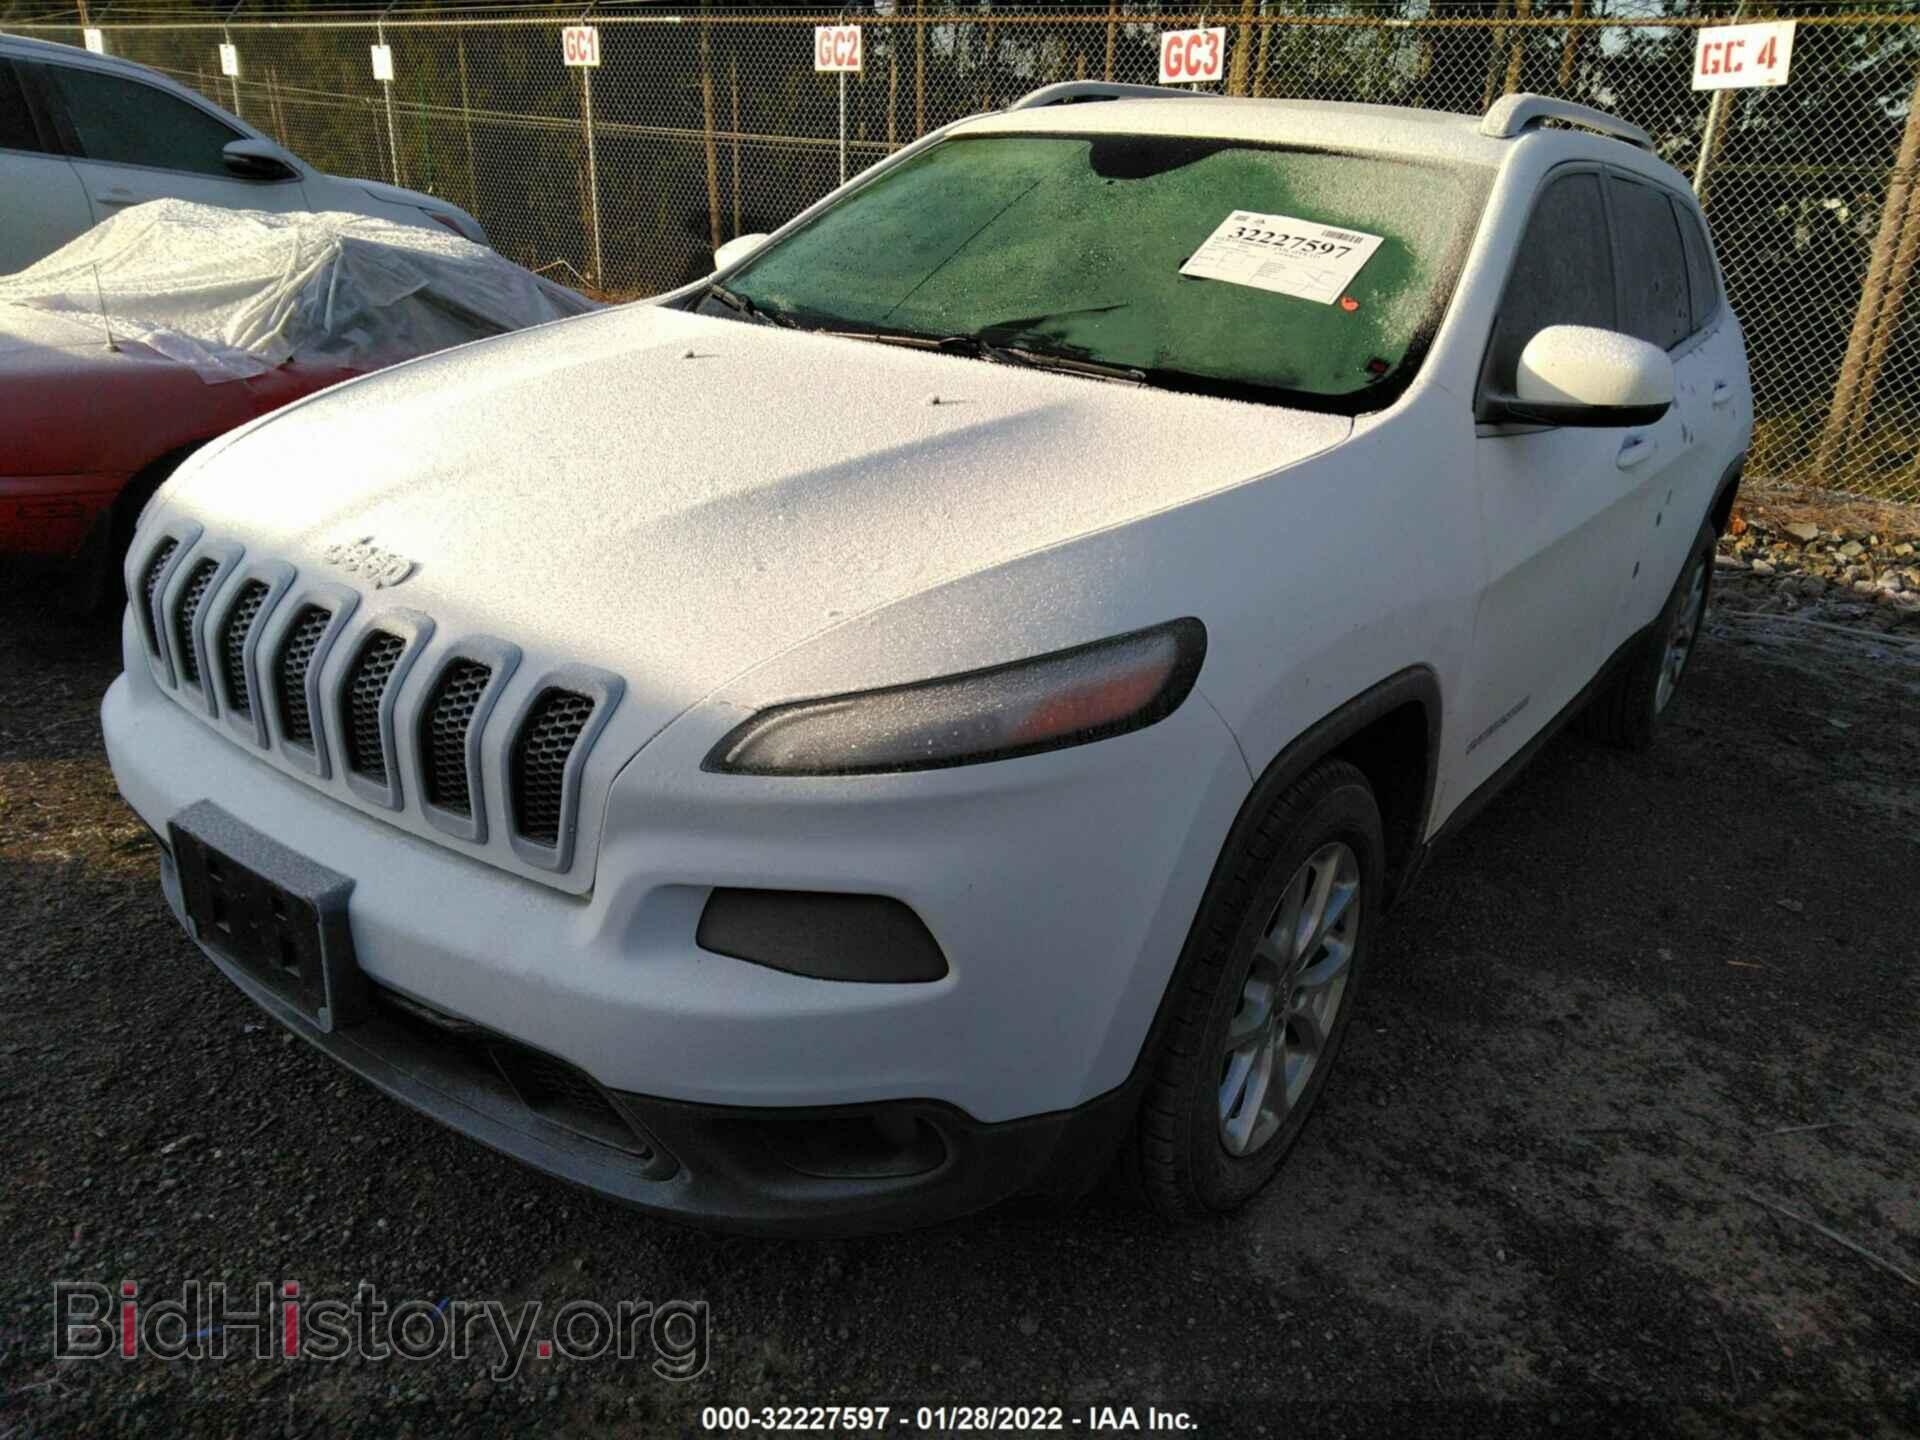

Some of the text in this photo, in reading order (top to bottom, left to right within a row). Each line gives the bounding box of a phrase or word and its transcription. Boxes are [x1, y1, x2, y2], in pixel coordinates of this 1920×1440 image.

[566, 30, 594, 61] GC1
[819, 31, 858, 66] GC2
[1164, 32, 1218, 77] GC3
[1700, 36, 1777, 75] GC 4
[1227, 227, 1353, 260] 32227597
